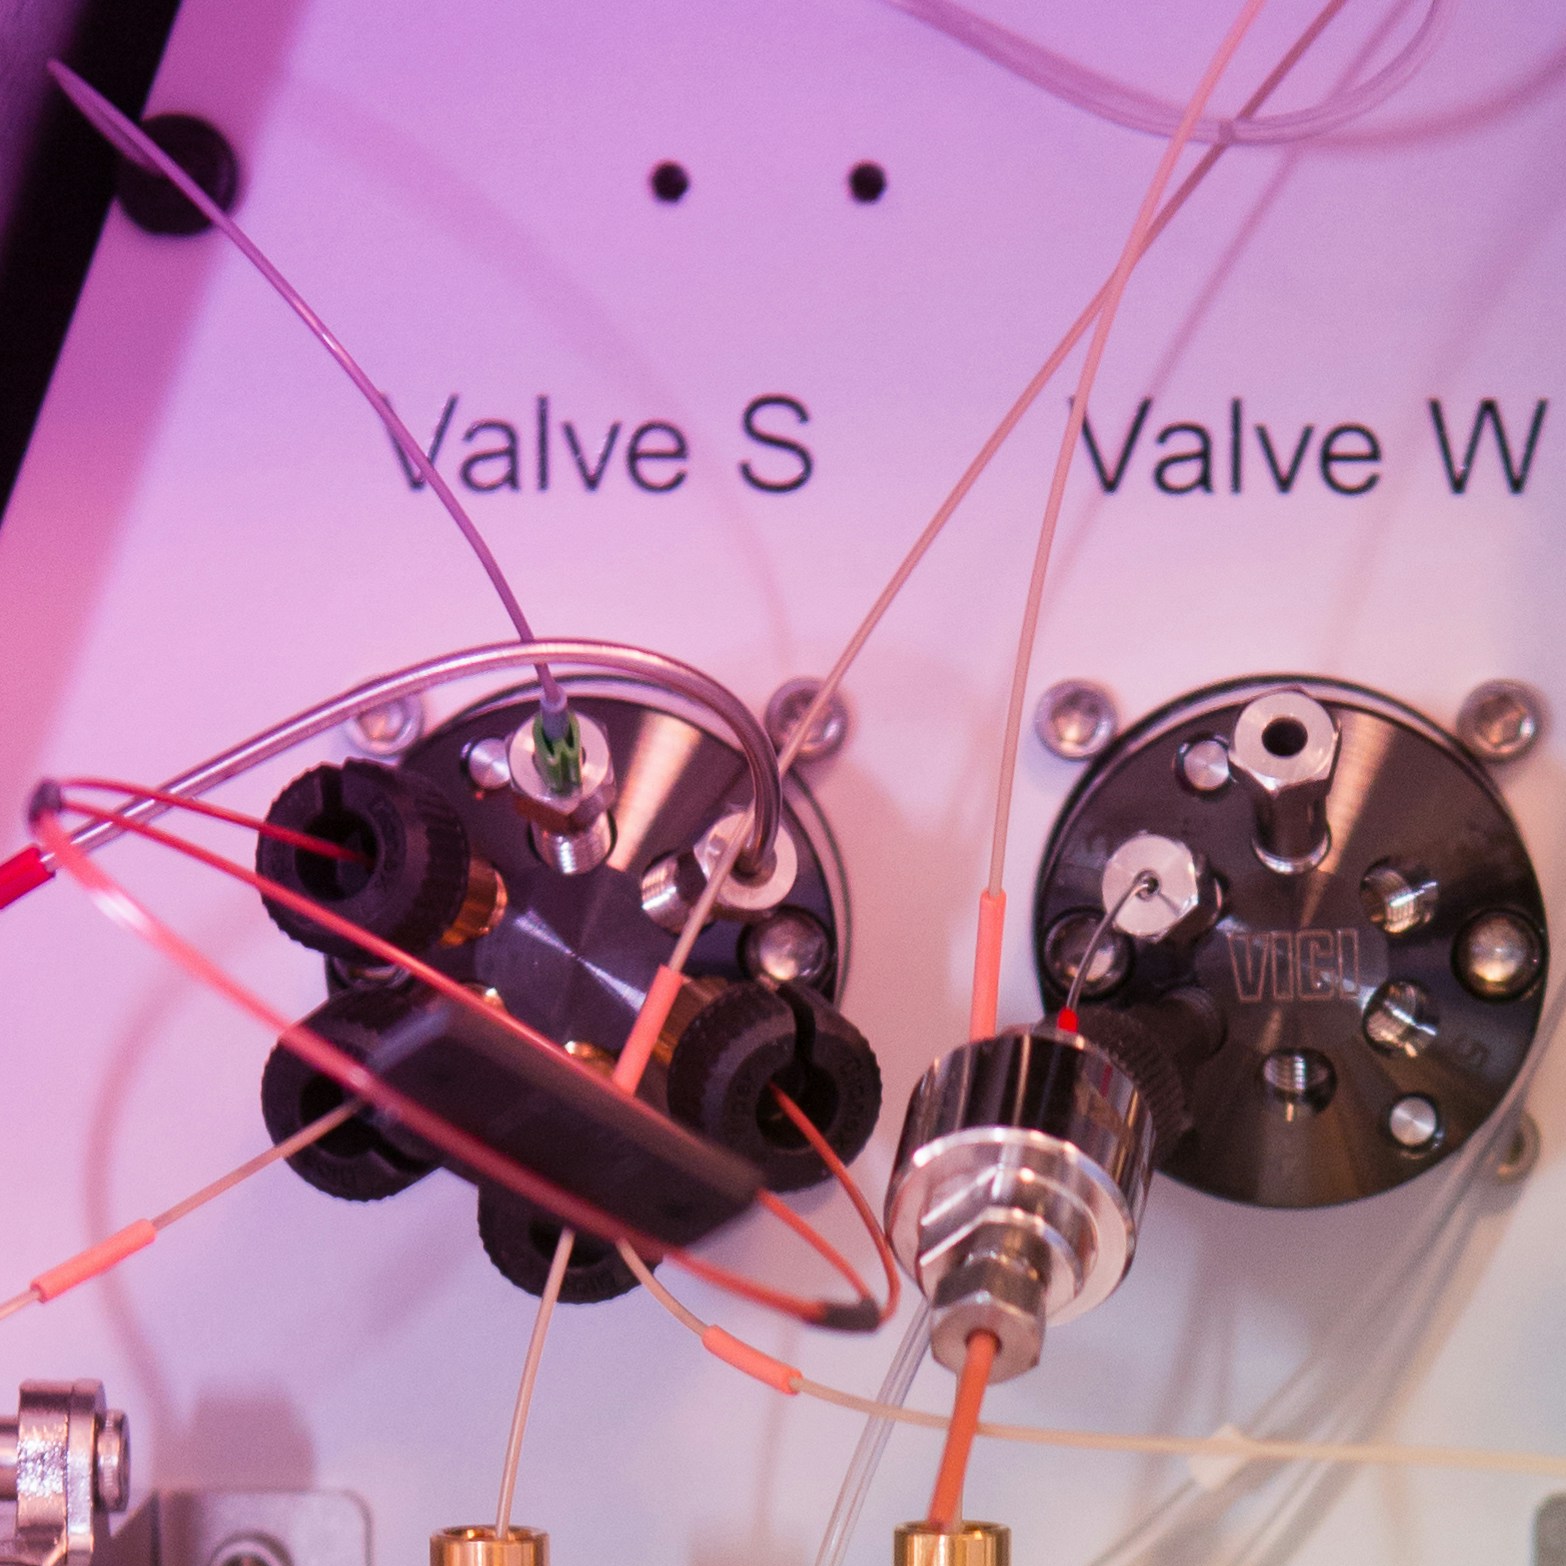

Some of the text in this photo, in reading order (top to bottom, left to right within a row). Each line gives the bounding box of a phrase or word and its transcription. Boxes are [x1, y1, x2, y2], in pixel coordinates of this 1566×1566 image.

[378, 392, 816, 496] Valve S
[1068, 395, 1549, 497] Valve W
[1227, 927, 1360, 1003] VICI
